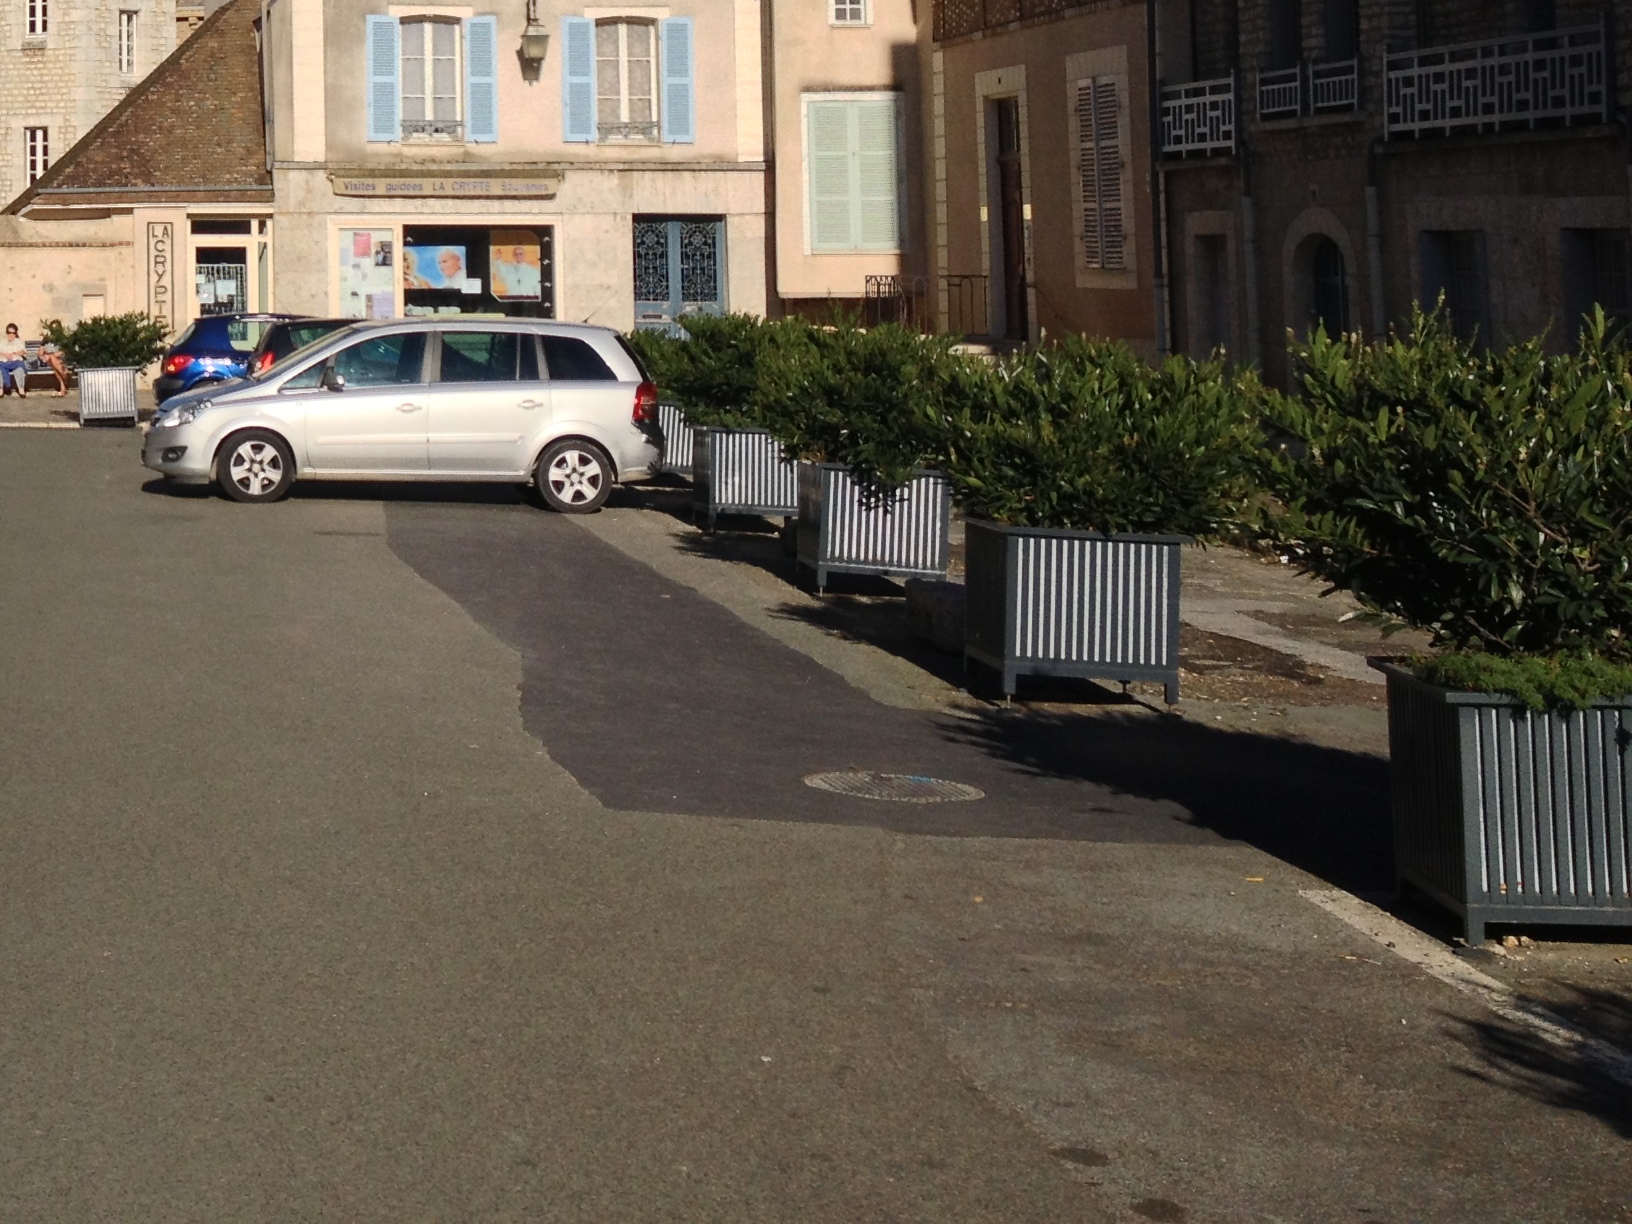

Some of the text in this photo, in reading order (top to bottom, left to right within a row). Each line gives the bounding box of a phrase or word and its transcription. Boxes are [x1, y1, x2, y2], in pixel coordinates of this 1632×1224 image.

[343, 180, 376, 191] Visites
[432, 181, 445, 191] LA
[451, 181, 491, 192] CRYPTE
[151, 225, 169, 238] LA
